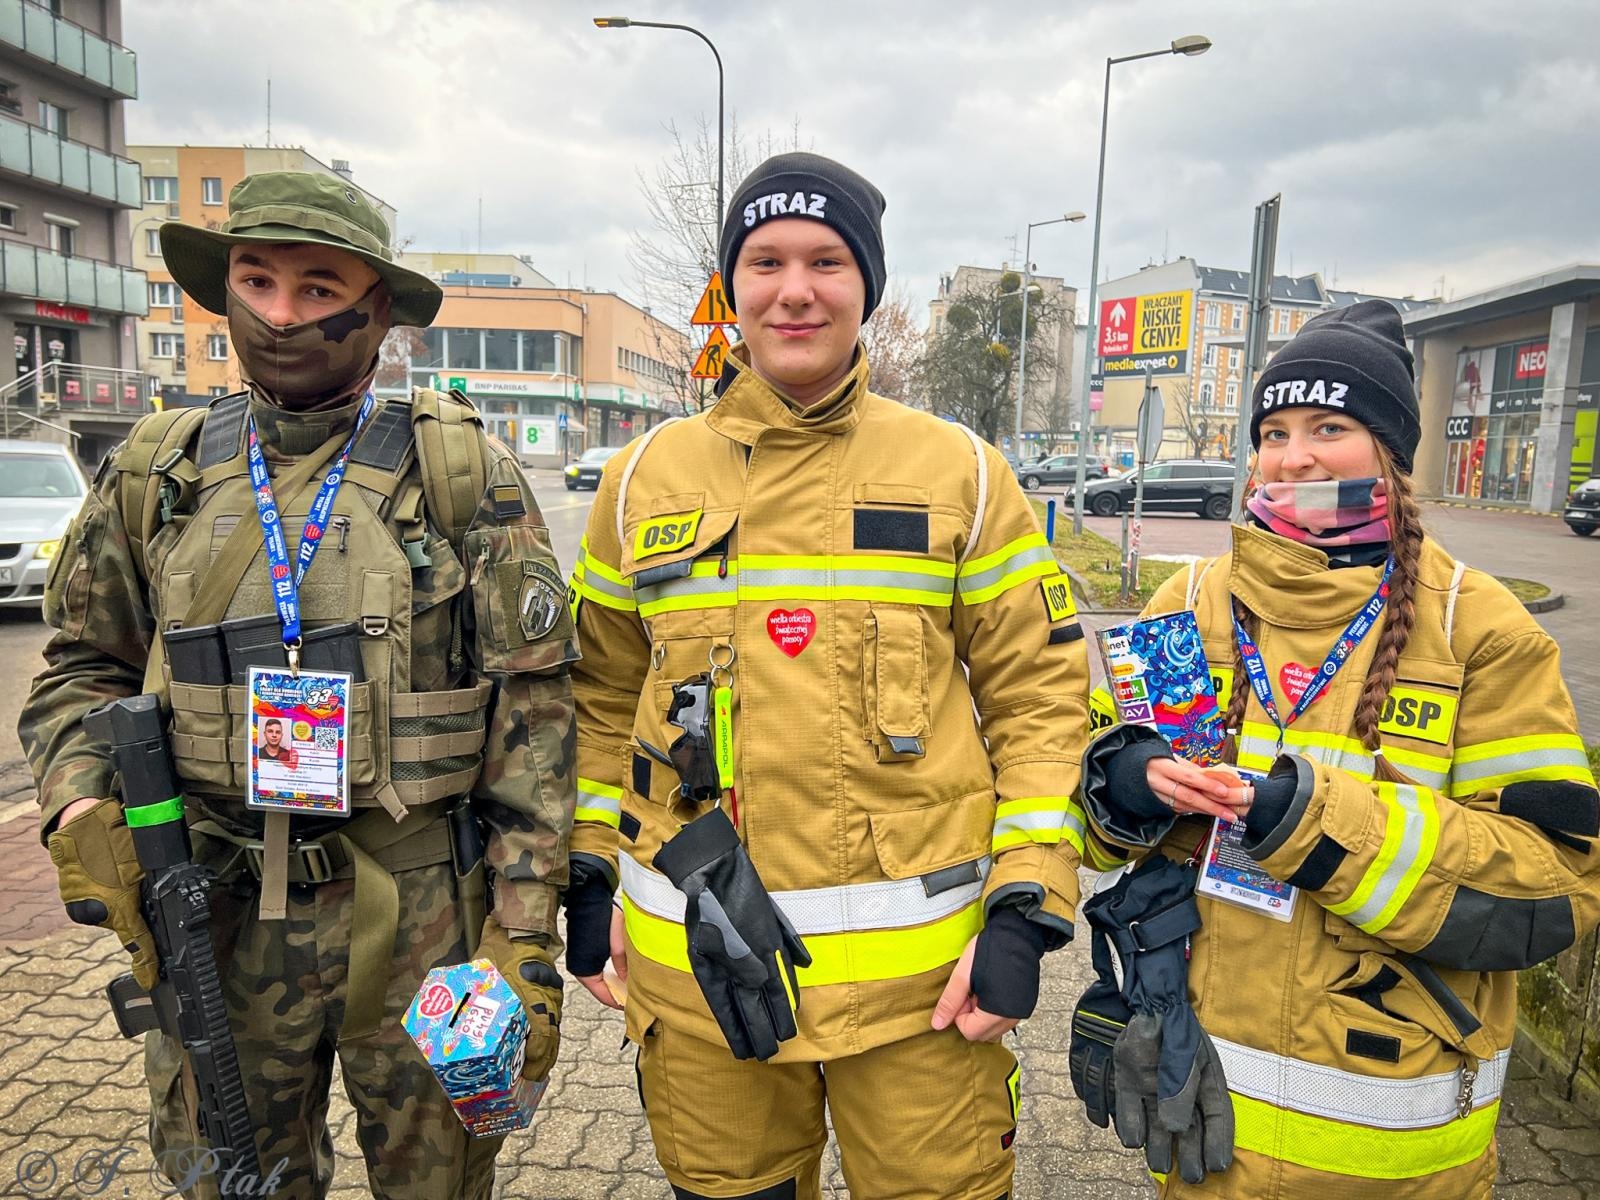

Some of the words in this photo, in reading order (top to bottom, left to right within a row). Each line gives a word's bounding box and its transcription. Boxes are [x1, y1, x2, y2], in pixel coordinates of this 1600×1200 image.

[1143, 295, 1184, 309] WŁĄCZAMY
[1142, 307, 1183, 328] NISKIE
[1141, 326, 1181, 349] CENY!
[1105, 356, 1168, 373] mediaexpert
[1519, 352, 1546, 372] NEO
[474, 382, 491, 391] BNP
[493, 383, 528, 392] PARIBAS
[1447, 417, 1469, 436] CCC
[643, 520, 693, 549] OSP
[300, 541, 315, 562] 112
[276, 580, 292, 598] 112
[1047, 583, 1069, 612] OSP
[1366, 598, 1383, 617] 112
[1347, 615, 1367, 636] PIERWSZA
[1355, 622, 1369, 638] POMOC
[781, 635, 803, 646] pomocy
[1246, 657, 1263, 675] 112
[306, 688, 333, 705] 33
[1120, 685, 1140, 696] ank
[1089, 708, 1114, 732] SP
[1379, 694, 1442, 730] OSP
